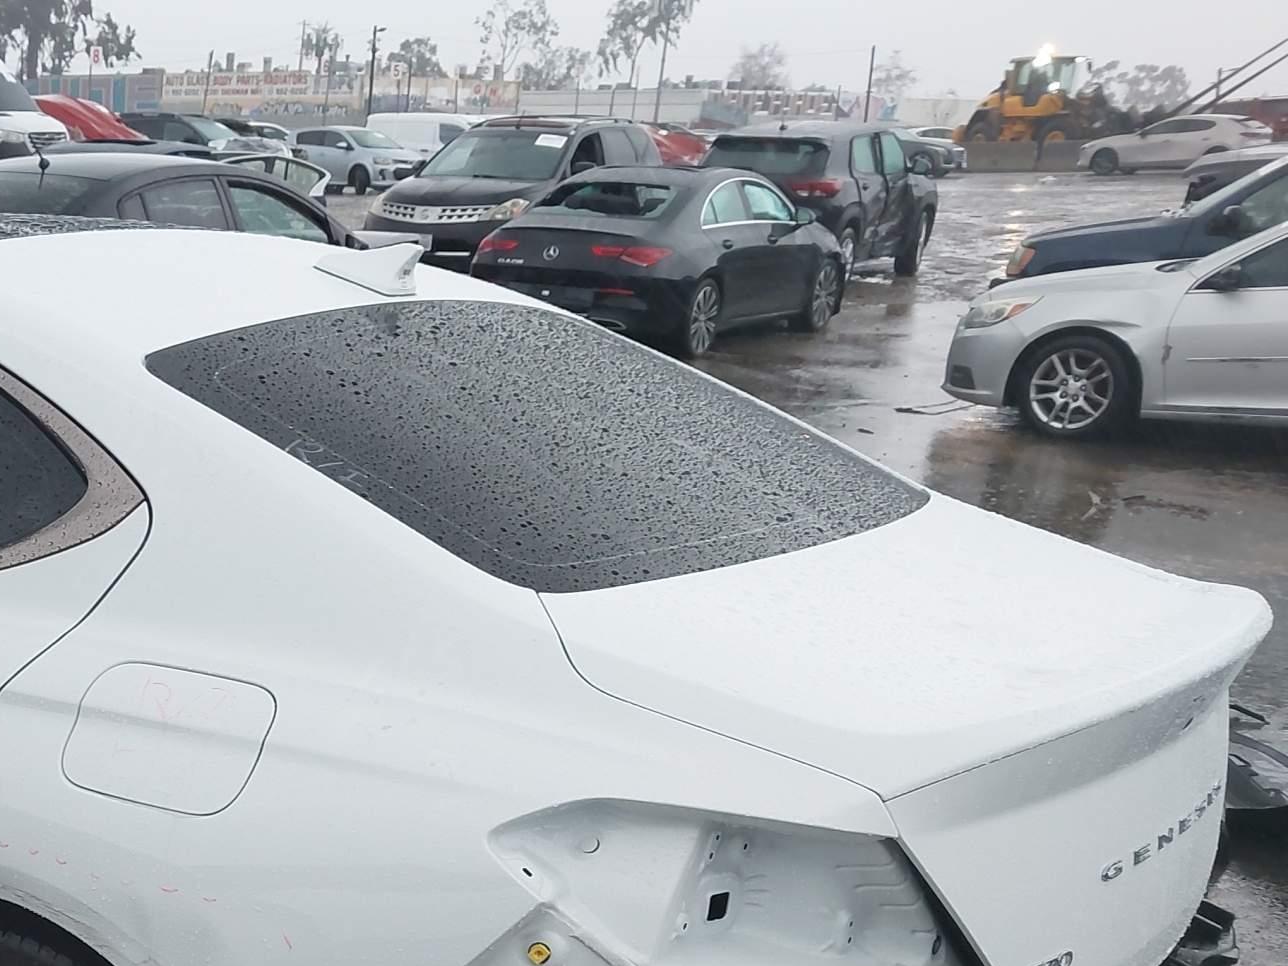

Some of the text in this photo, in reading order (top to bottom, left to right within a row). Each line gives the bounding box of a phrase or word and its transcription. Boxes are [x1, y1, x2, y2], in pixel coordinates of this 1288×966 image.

[92, 48, 100, 63] 8
[393, 64, 401, 77] 5
[1100, 778, 1223, 883] GENESIS
